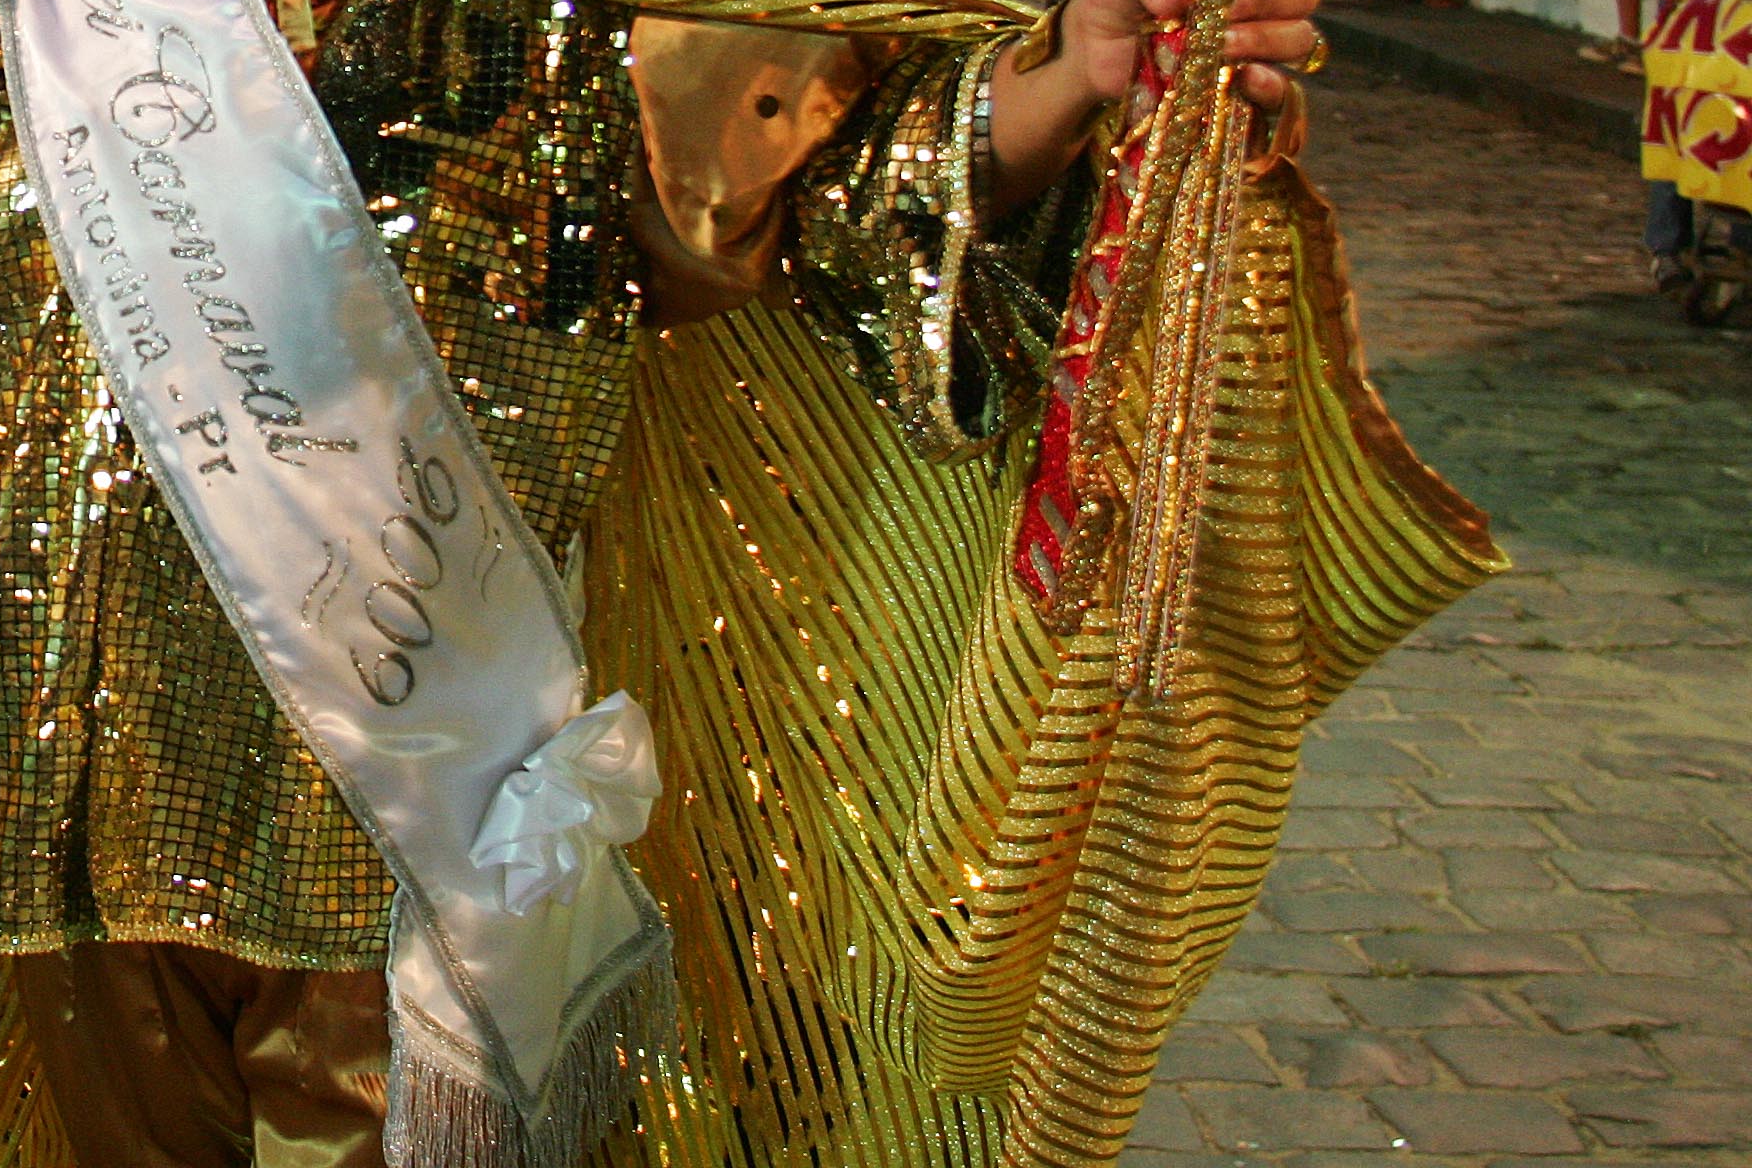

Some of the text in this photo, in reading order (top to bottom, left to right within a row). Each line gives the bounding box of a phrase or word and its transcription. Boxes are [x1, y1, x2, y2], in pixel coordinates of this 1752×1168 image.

[51, 124, 172, 372] Antonina
[109, 24, 358, 467] Carnaval
[349, 436, 459, 707] 2009
